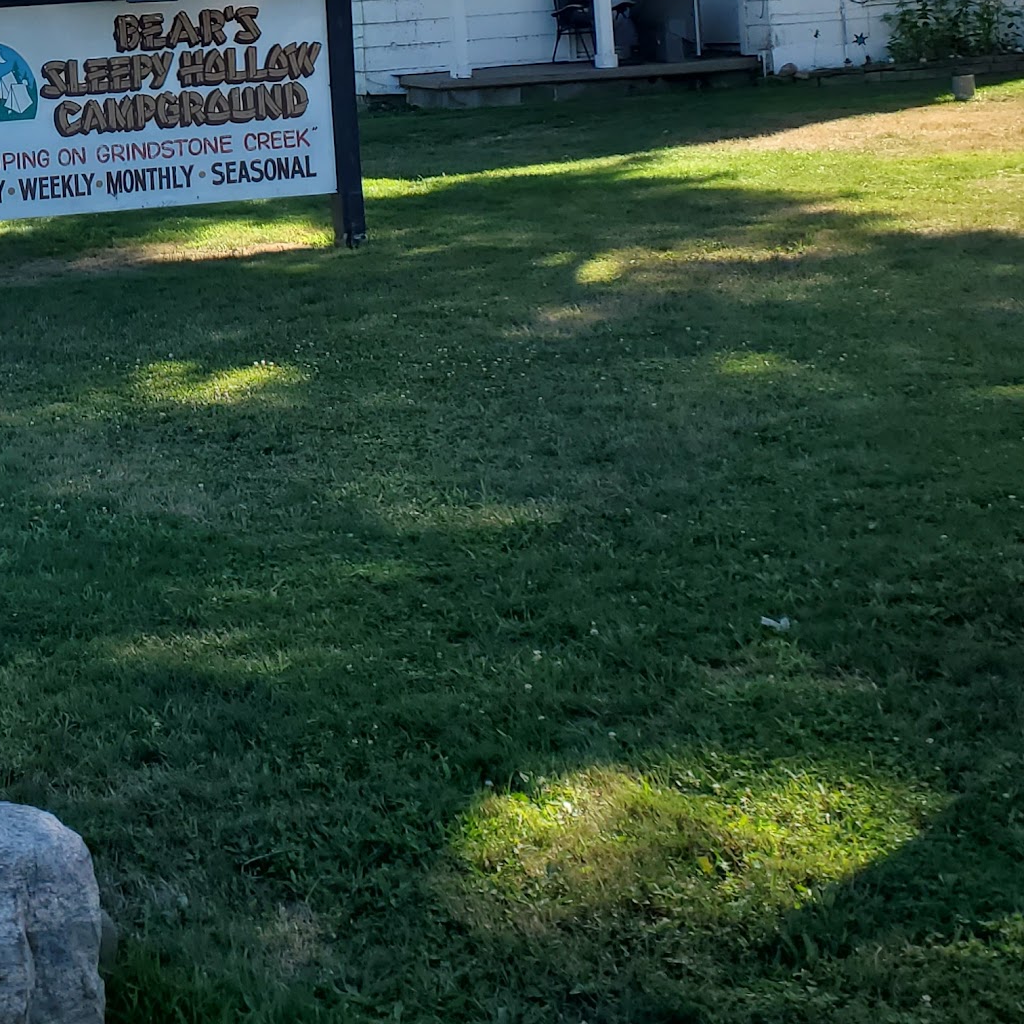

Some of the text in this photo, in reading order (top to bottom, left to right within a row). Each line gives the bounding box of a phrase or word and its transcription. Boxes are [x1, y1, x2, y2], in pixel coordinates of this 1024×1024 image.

[113, 6, 261, 52] BEAR'S
[40, 42, 322, 98] SLEEPY HOLLOW
[54, 81, 309, 137] CAMPGROUND
[58, 146, 86, 166] ON
[96, 135, 233, 163] GRINDSTONE
[18, 173, 95, 201] WEEKLY
[106, 165, 194, 194] MONTHLY
[211, 155, 317, 185] SEASONAL
